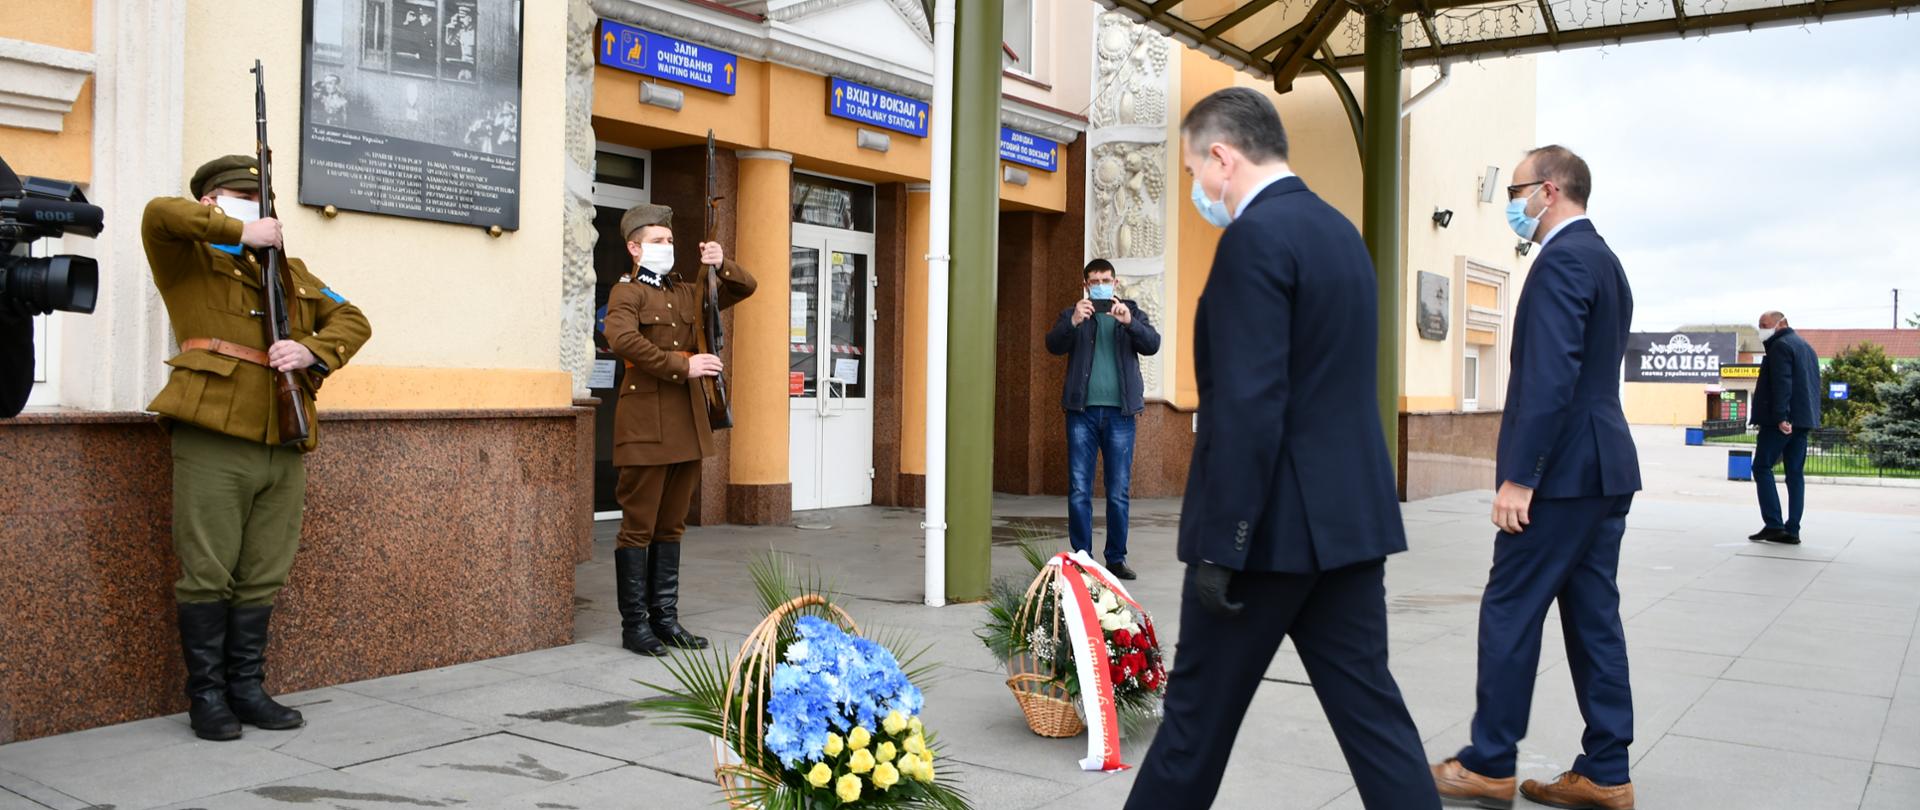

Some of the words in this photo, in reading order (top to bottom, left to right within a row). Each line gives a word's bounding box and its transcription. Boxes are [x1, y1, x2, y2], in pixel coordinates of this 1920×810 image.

[674, 42, 698, 57] ЗАЛИ
[657, 50, 713, 74] ОЧІКУВАННЯ
[657, 63, 688, 78] WAITING
[689, 70, 712, 83] HALLS
[846, 86, 870, 107] ВХІД
[872, 93, 878, 107] У
[880, 95, 916, 117] ВОКЗАЛ
[846, 103, 856, 115] TO
[857, 106, 887, 123] RAILWAY
[887, 114, 915, 130] STATION
[1640, 355, 1719, 370] КОЛИБА
